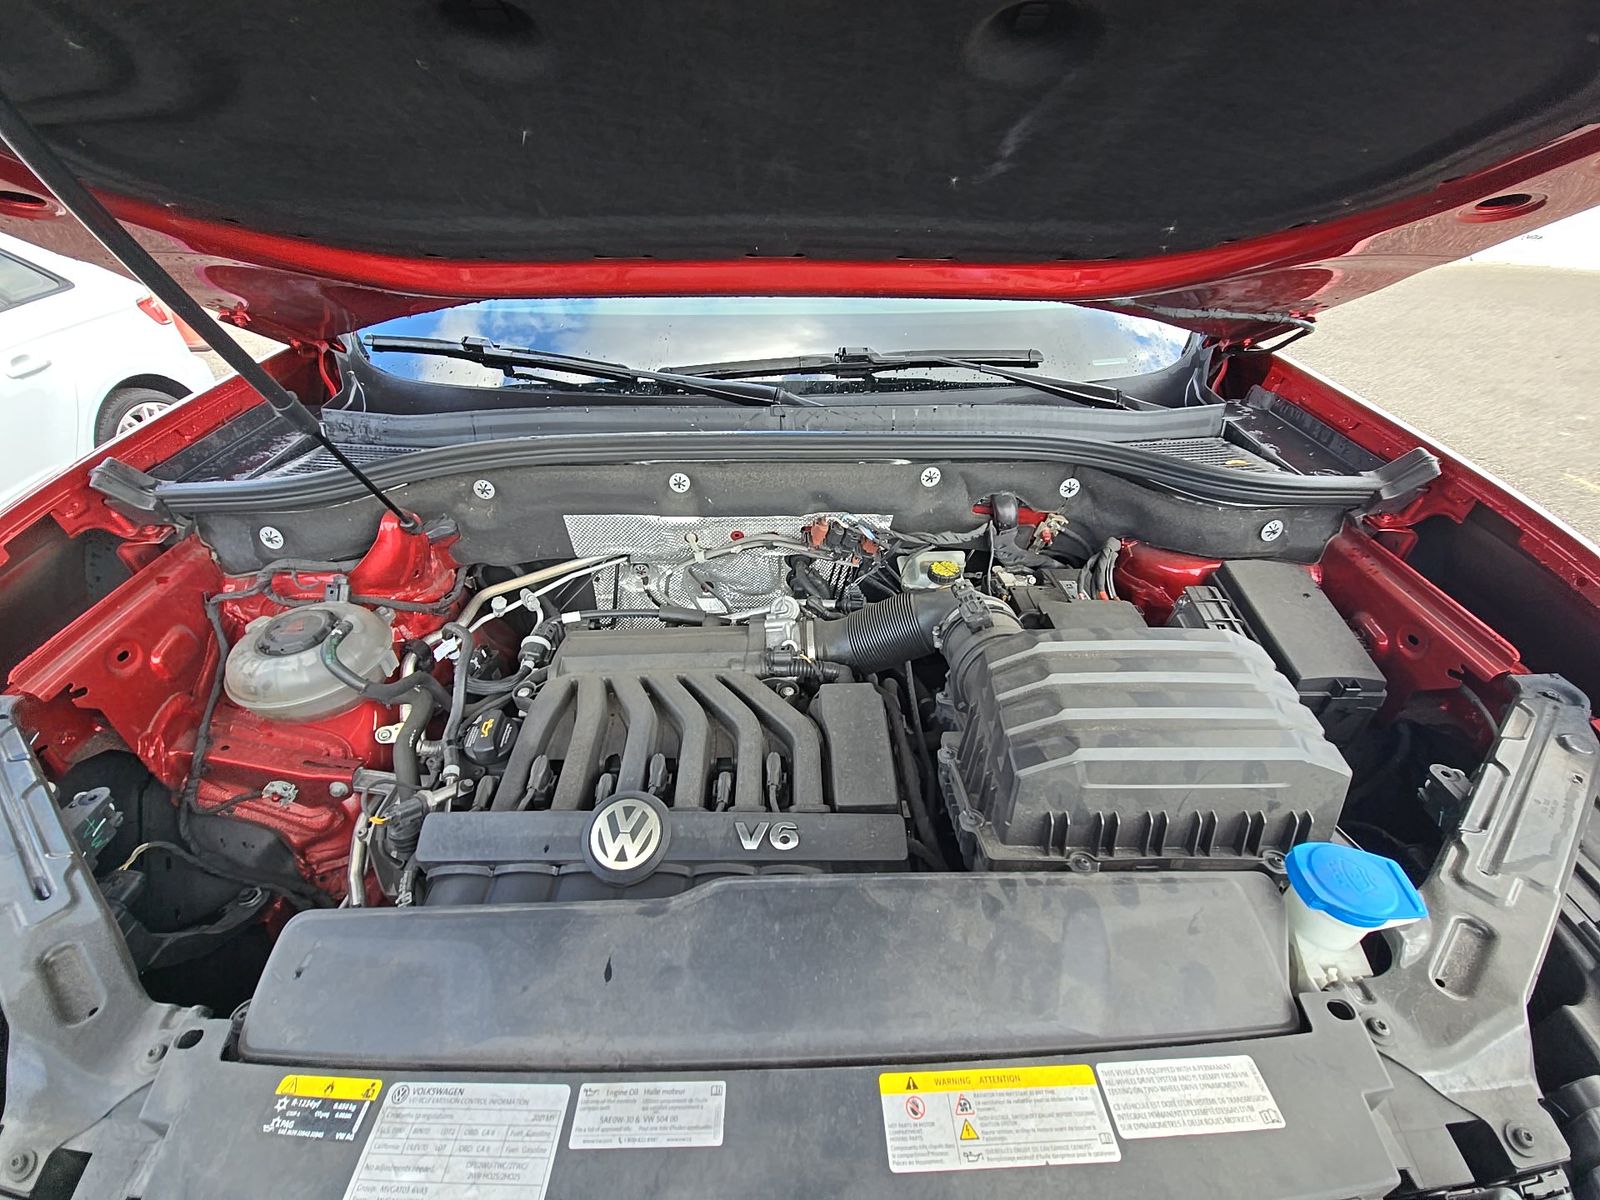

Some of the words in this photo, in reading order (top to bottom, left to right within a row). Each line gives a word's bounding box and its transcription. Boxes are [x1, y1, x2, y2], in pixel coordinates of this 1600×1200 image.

[734, 821, 799, 850] V6
[934, 1076, 971, 1086] WARNING
[978, 1074, 1020, 1083] ATTENTION
[411, 1087, 464, 1095] VOLKSWAGEN
